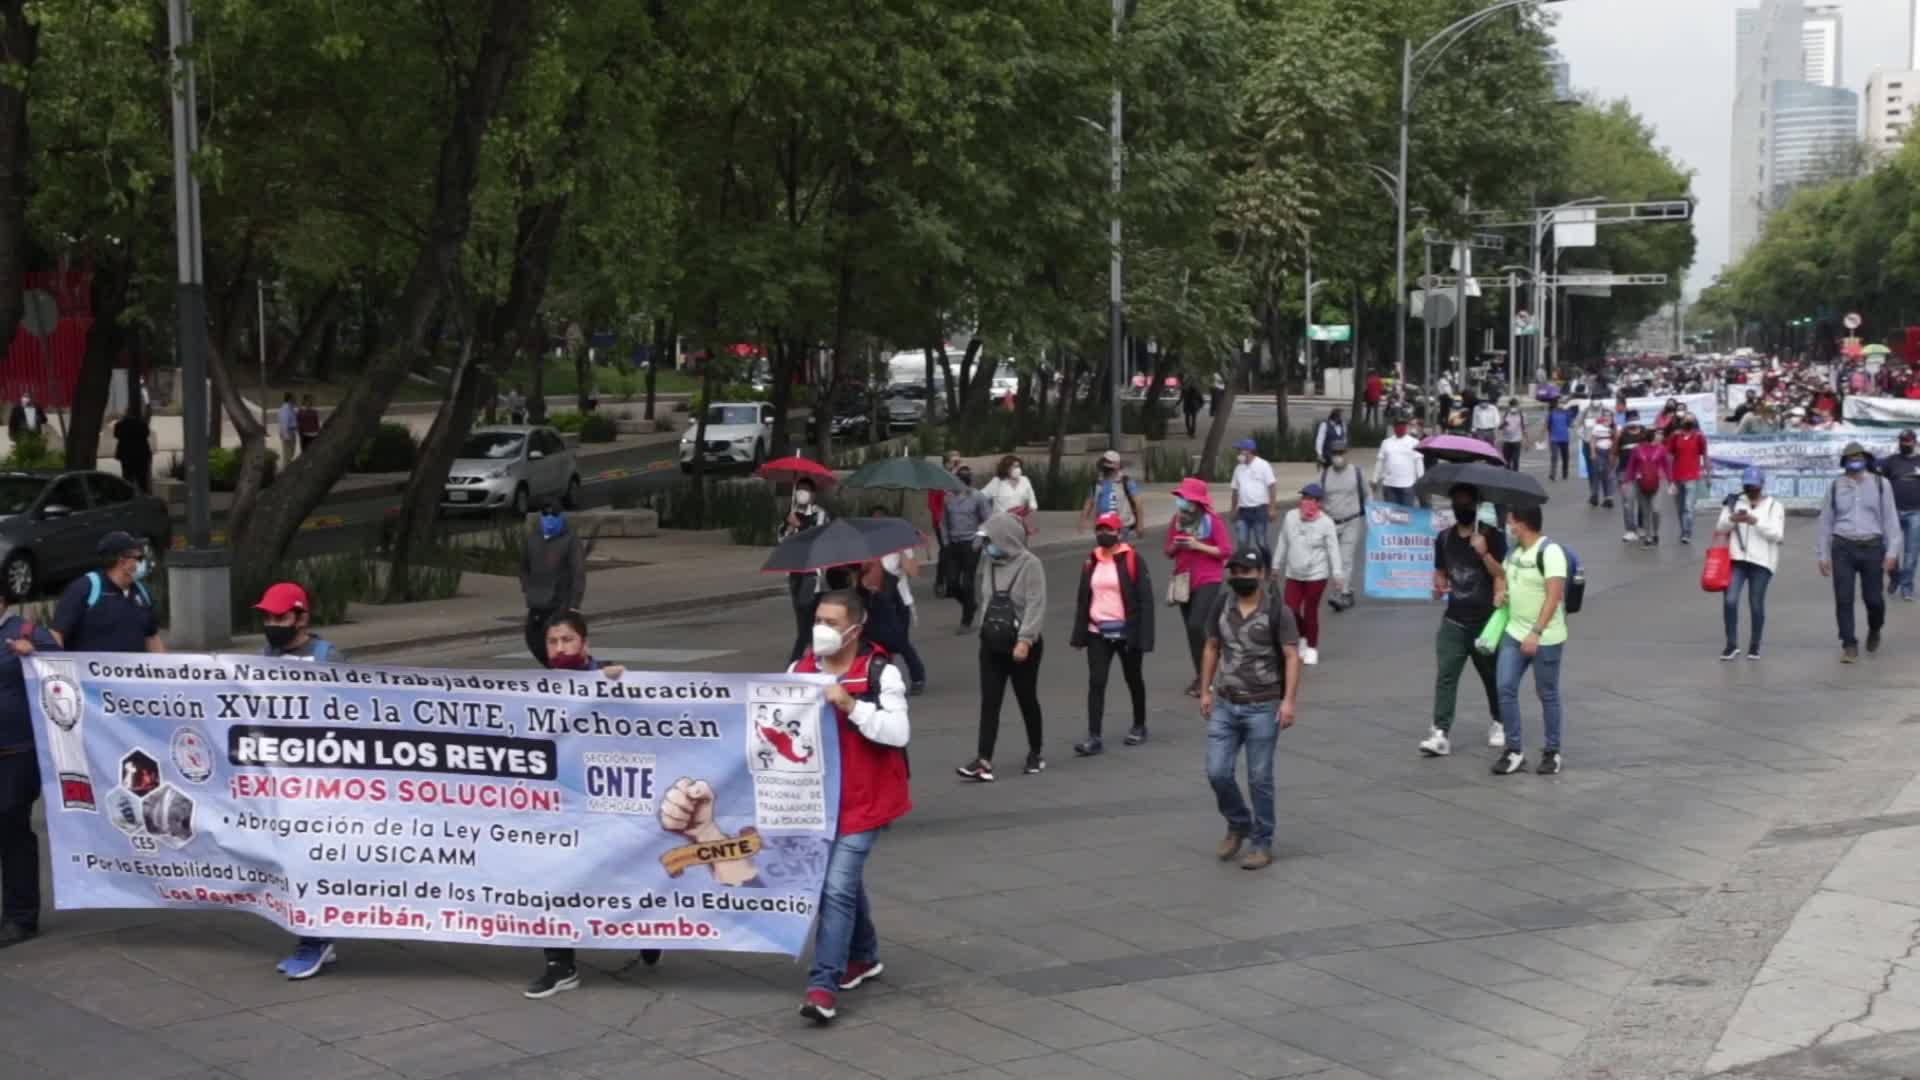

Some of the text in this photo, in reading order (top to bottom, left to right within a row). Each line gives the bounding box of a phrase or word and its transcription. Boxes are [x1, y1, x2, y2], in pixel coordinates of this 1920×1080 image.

[89, 661, 730, 699] Coordinadora Nacional de Trabajadores de la Educación
[103, 690, 205, 718] Sección
[217, 694, 311, 720] XVIII
[324, 697, 359, 721] de
[372, 699, 401, 723] la
[413, 700, 515, 735] CNTE,
[527, 707, 720, 738] Michoacán
[238, 731, 366, 765] REGIÓN
[375, 740, 438, 768] LOS
[446, 744, 548, 775] REYES
[230, 775, 561, 812] ¡EXIGIMOS SOLUCIÓN!
[587, 765, 653, 799] CNTE
[132, 836, 156, 850] CES
[236, 811, 579, 847] Abrogación de la Ley General
[309, 843, 476, 866] del USICAMM
[697, 839, 753, 861] CNTE
[115, 858, 132, 873] la
[134, 860, 233, 879] Estabilidad
[296, 882, 309, 899] y
[317, 879, 408, 897] Salarial
[415, 881, 442, 899] de
[449, 882, 476, 902] los
[481, 886, 632, 912] Trabajadores
[639, 892, 667, 909] de
[675, 891, 695, 908] la
[324, 905, 432, 931] Peribán,
[442, 910, 579, 940] Tingüindín,
[588, 916, 718, 937] Tocumbo.
